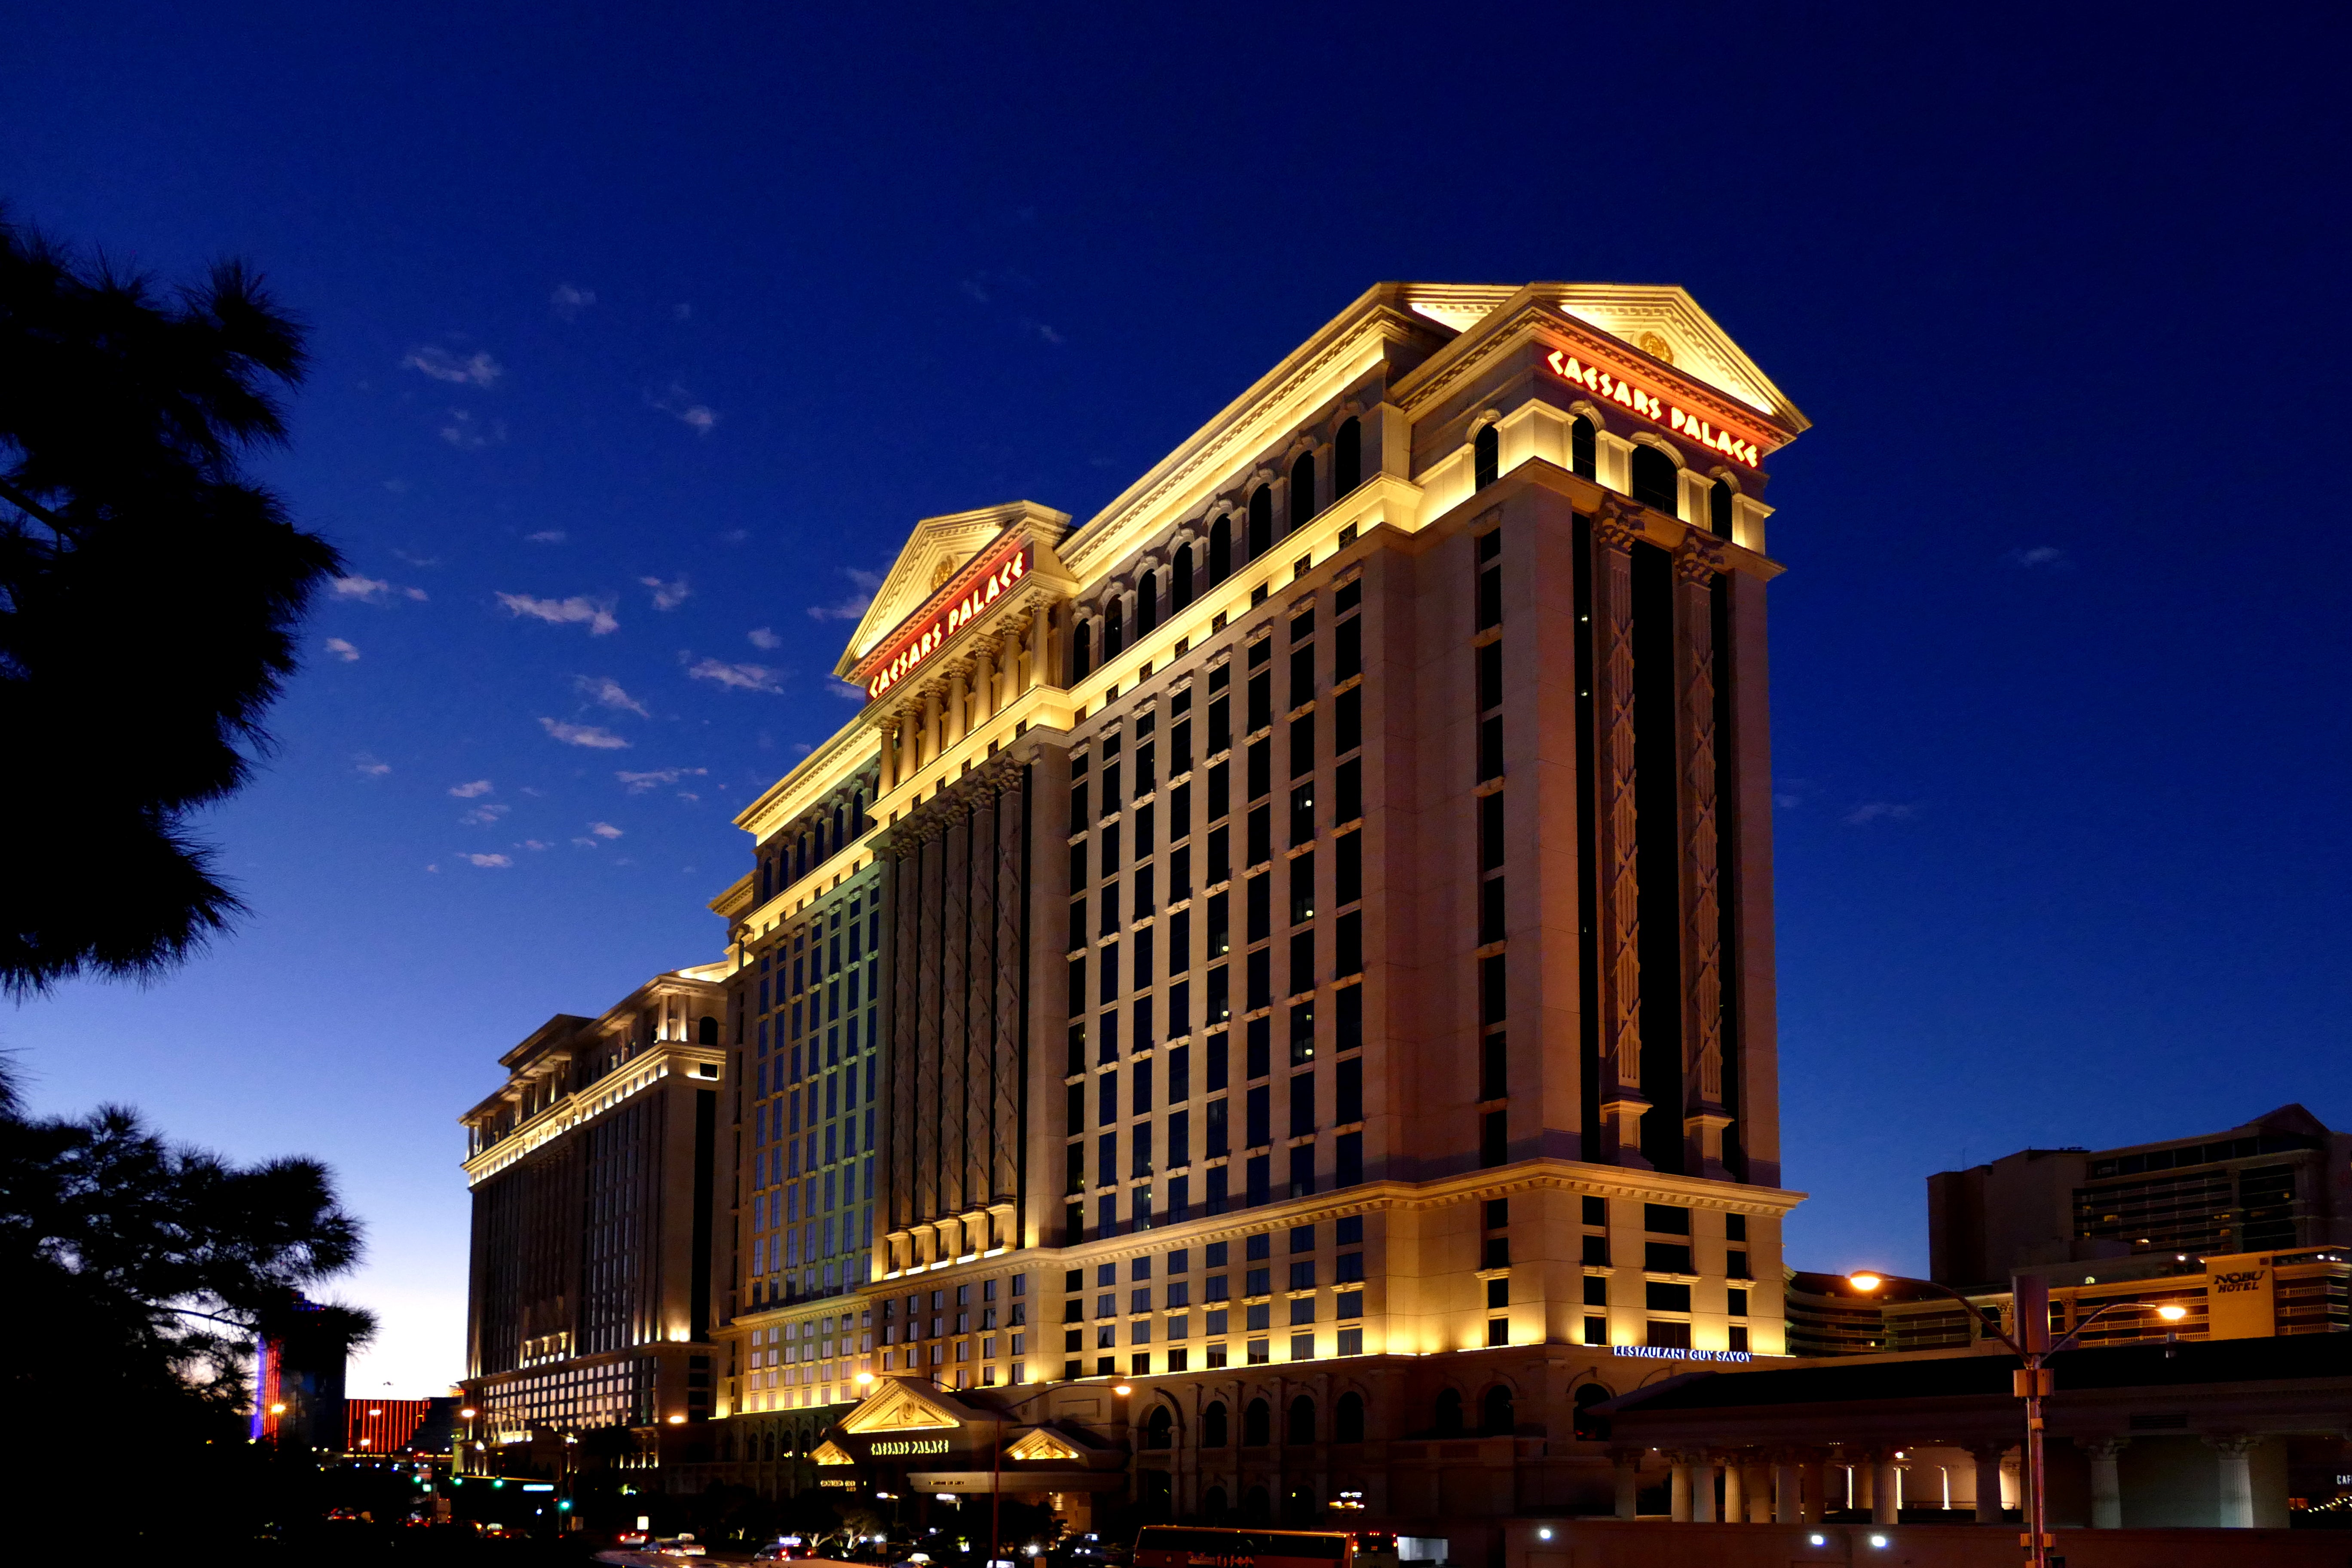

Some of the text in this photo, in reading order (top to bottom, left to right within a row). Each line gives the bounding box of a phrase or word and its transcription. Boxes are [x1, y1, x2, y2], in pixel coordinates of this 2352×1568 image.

[1547, 350, 1758, 468] CAESARS PALACE
[869, 551, 1024, 699] CAESARS PALACE
[2214, 1270, 2265, 1285] NOBU
[2218, 1281, 2259, 1293] HOTEL
[1614, 1345, 1752, 1362] RESTAURANT GUY SAVOY
[2337, 1475, 2352, 1485] CAF
